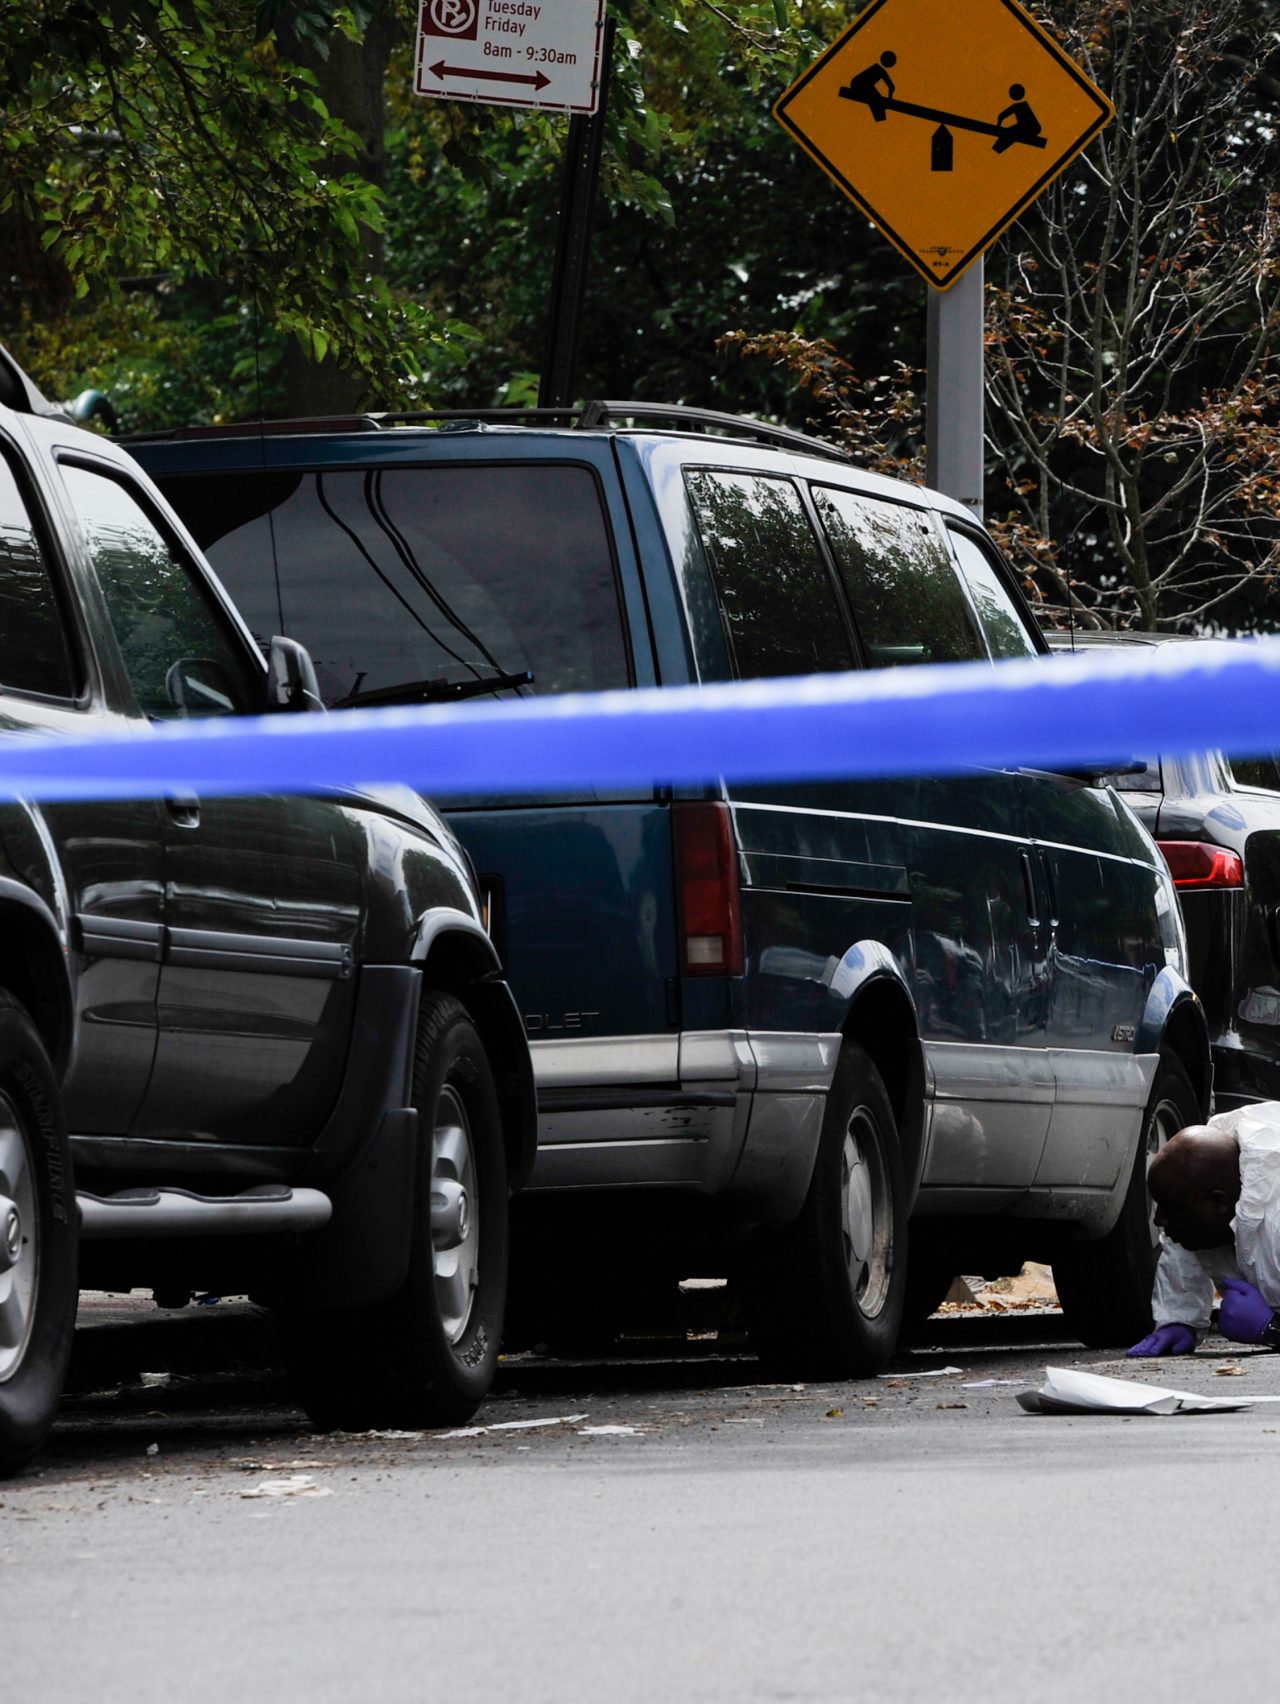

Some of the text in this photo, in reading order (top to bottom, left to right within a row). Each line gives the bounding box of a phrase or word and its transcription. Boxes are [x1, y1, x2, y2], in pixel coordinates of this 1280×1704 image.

[486, 0, 541, 20] Tuesday
[485, 16, 526, 37] Friday
[483, 41, 512, 58] 8am
[526, 46, 577, 65] 9:30am
